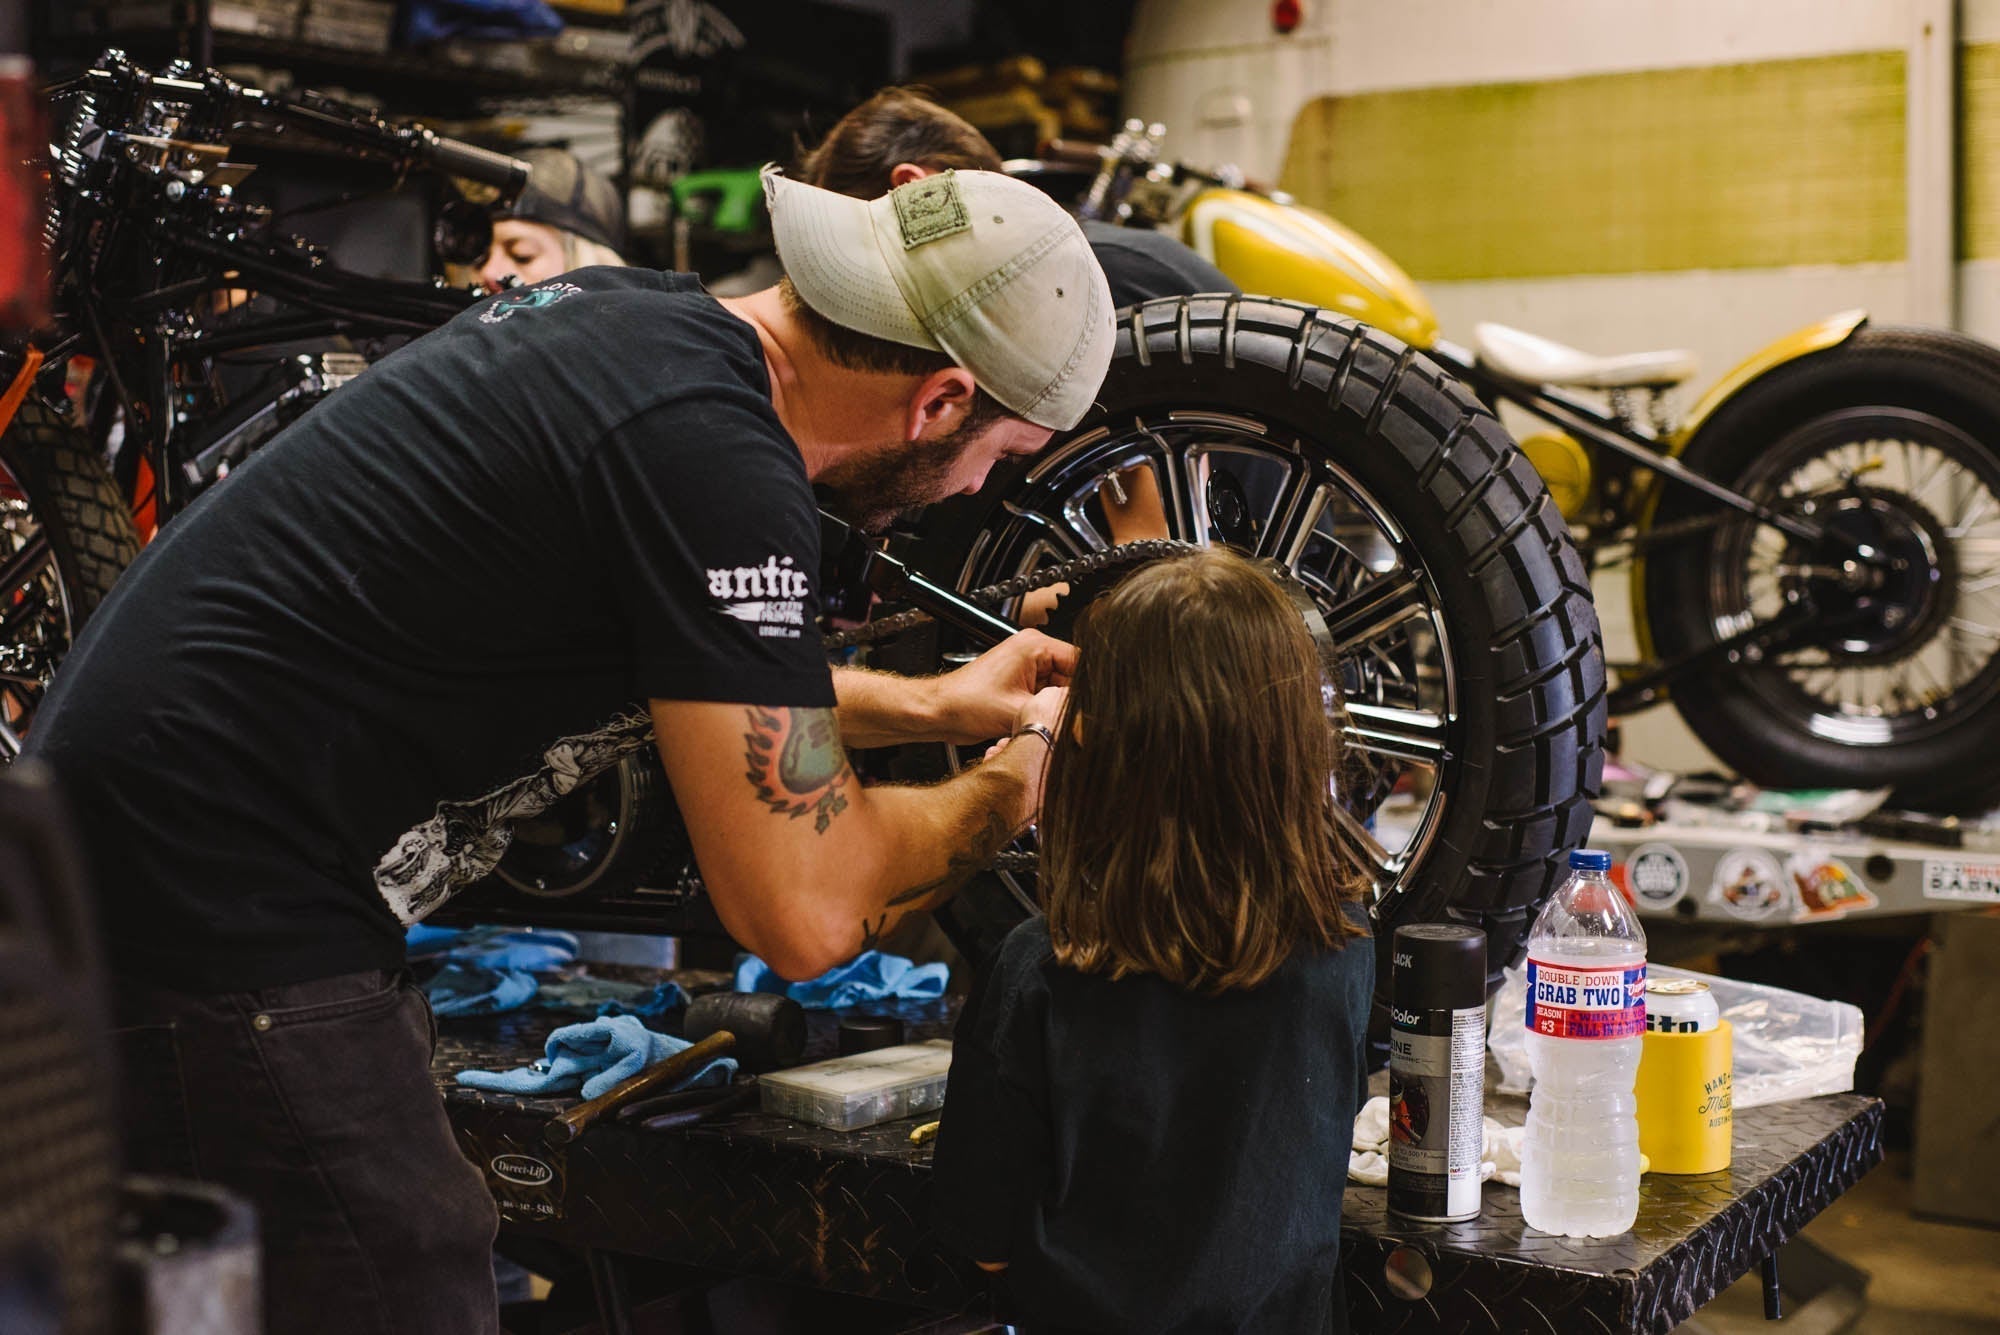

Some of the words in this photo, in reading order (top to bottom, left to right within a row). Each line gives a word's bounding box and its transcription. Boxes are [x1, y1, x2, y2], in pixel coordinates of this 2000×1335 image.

[1539, 970, 1580, 986] DOUBLE
[1585, 975, 1620, 987] DOWN
[1538, 982, 1577, 1005] GRAB
[1583, 987, 1620, 1006] TWO
[1536, 1005, 1562, 1019] REASON
[1541, 1019, 1555, 1033] #3
[1569, 1022, 1599, 1037] FALL
[1603, 1022, 1614, 1036] IN
